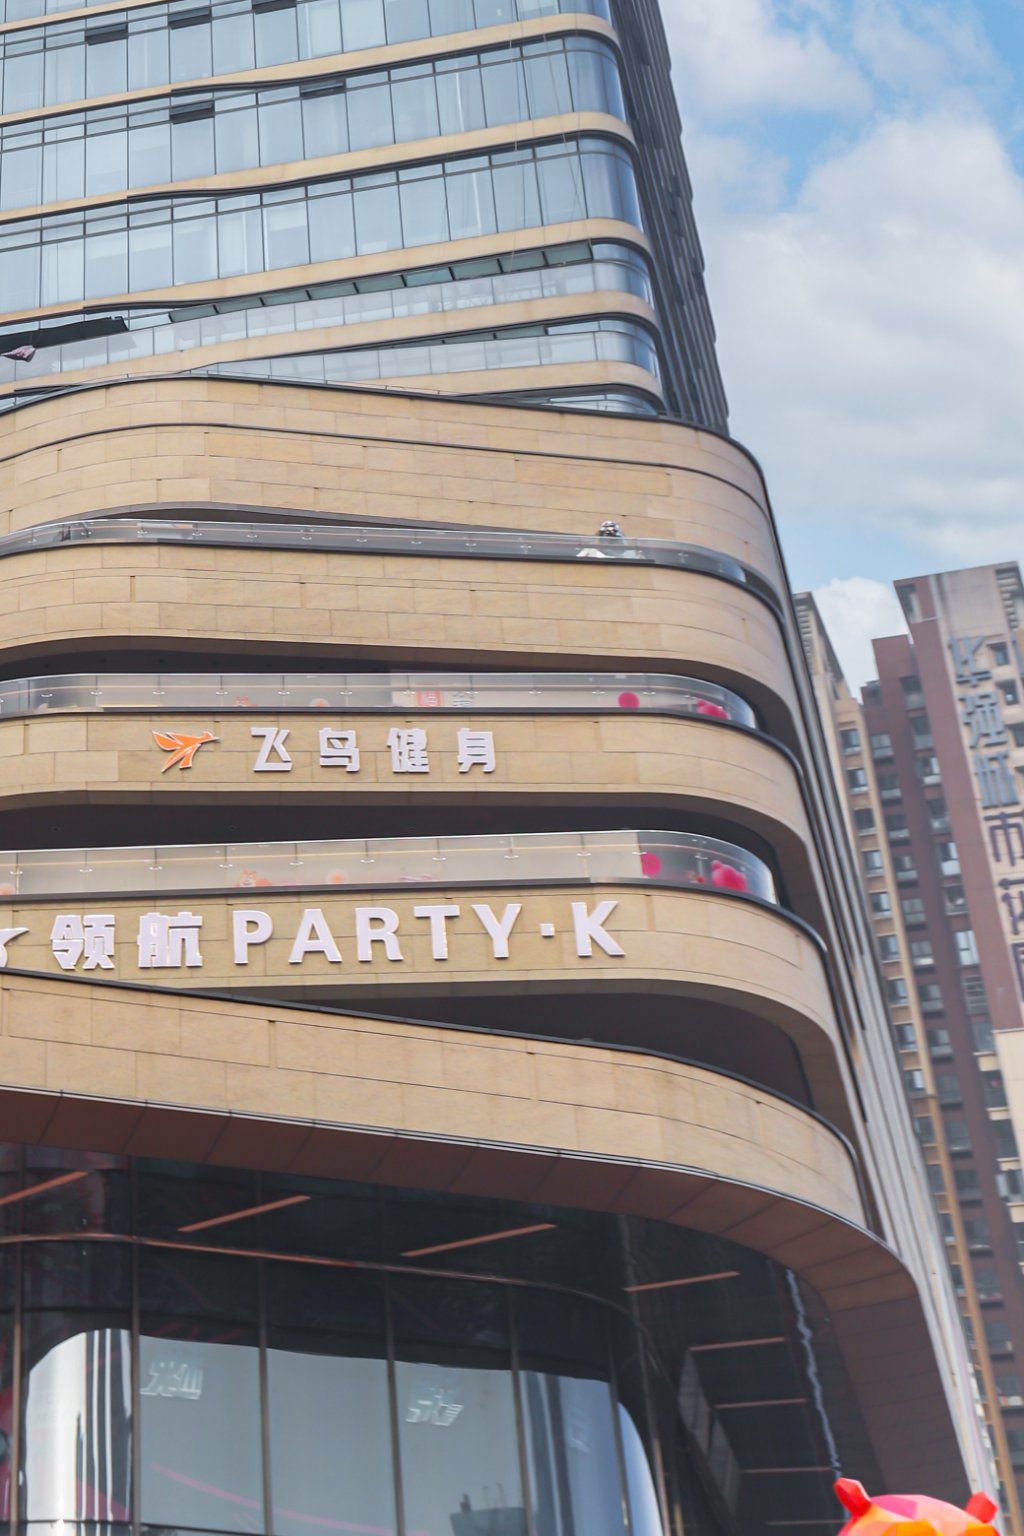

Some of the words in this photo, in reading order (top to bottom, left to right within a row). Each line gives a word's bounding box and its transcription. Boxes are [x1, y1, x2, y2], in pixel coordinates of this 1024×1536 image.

[251, 726, 496, 773] 飞鸟健身
[49, 911, 204, 970] 领航
